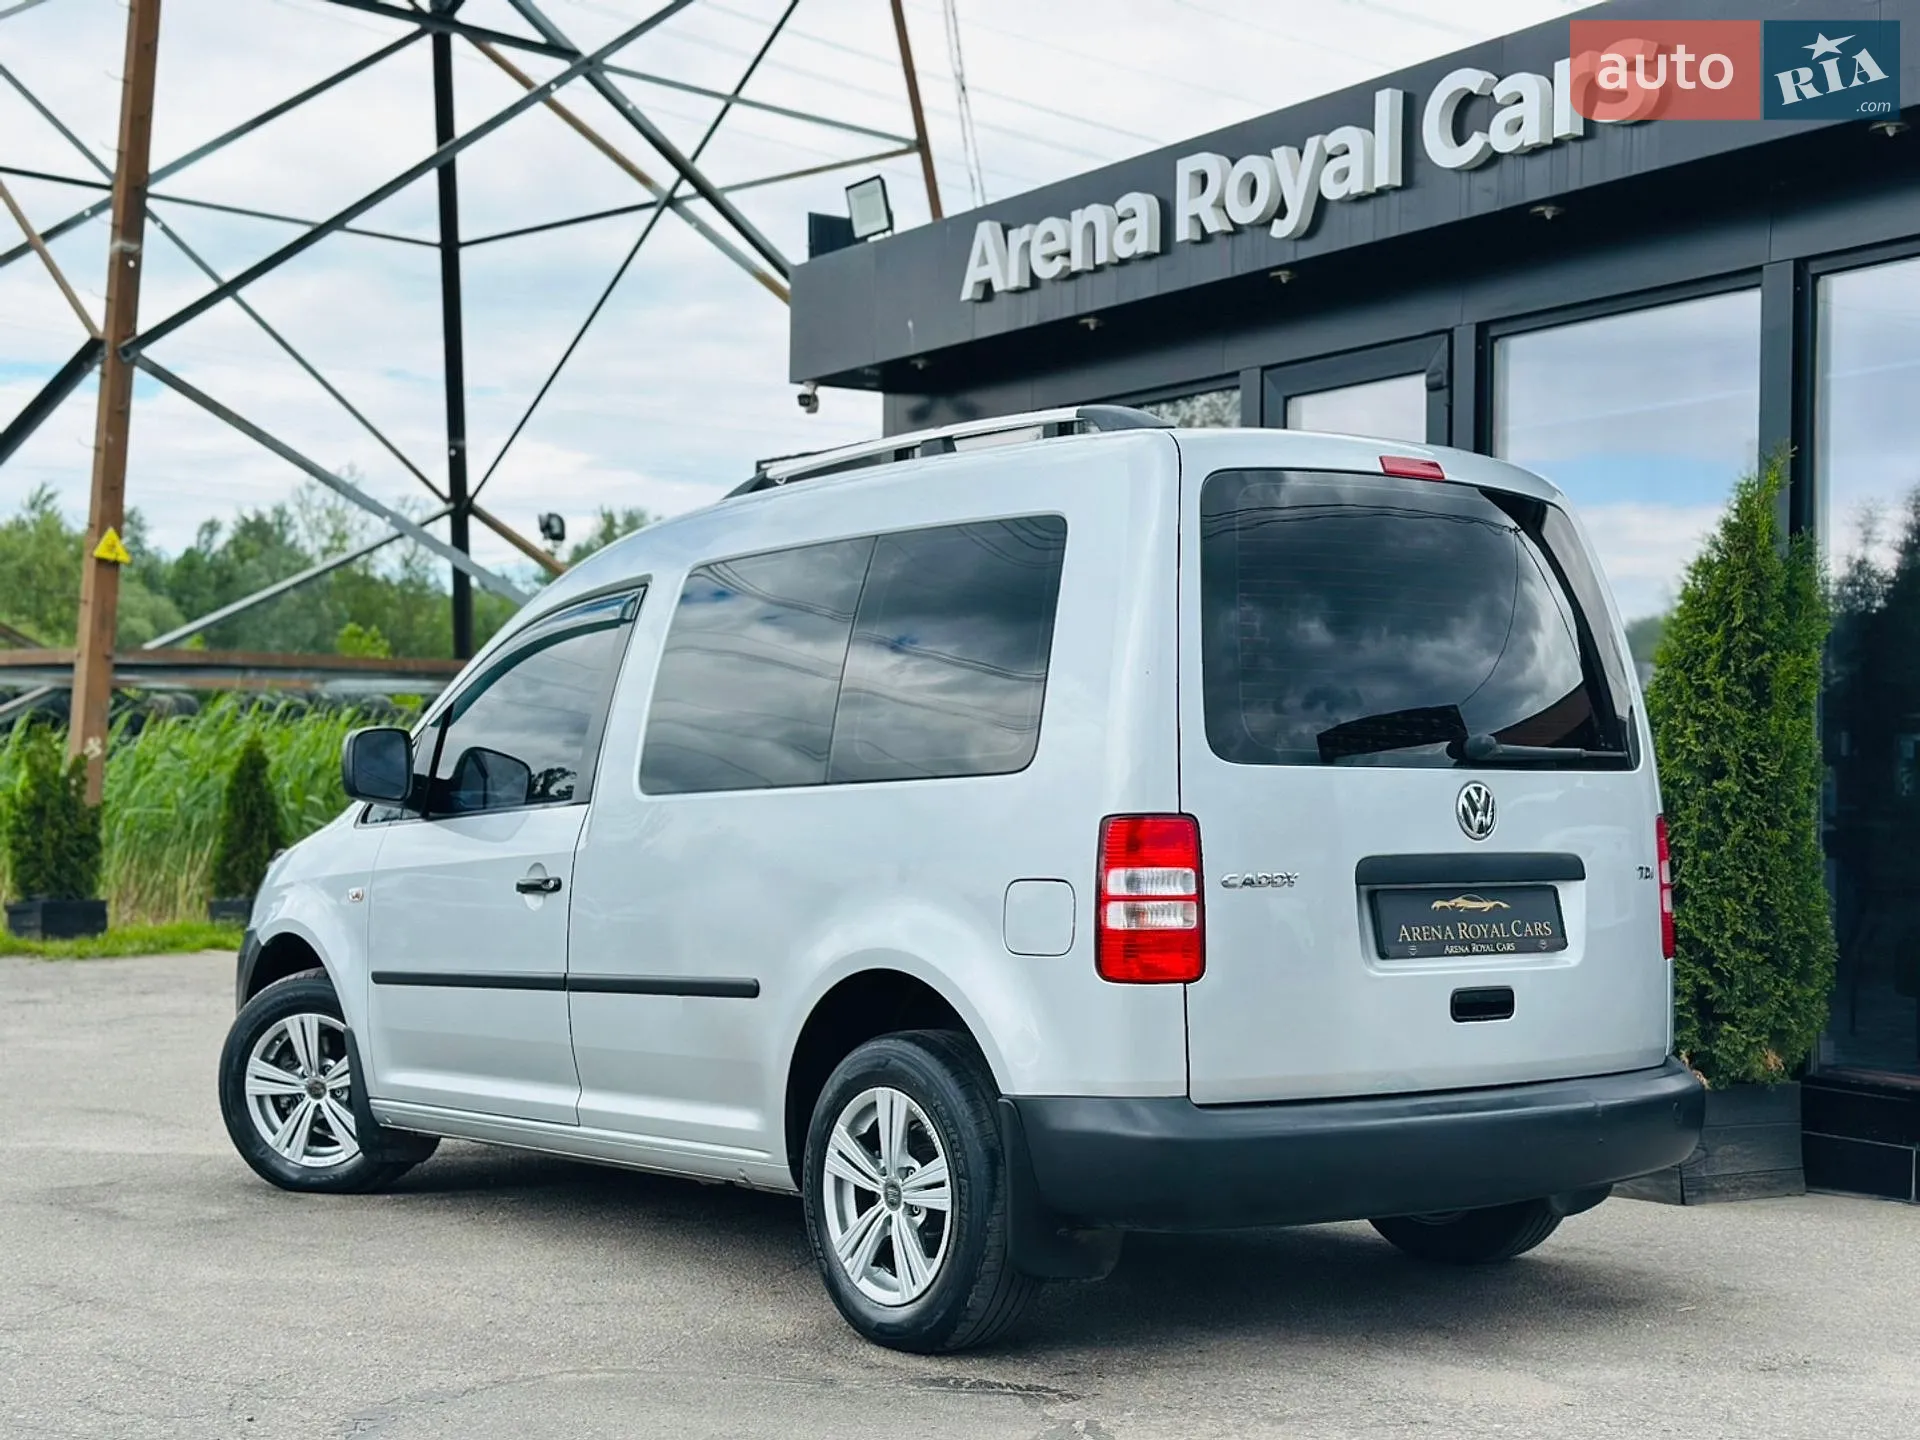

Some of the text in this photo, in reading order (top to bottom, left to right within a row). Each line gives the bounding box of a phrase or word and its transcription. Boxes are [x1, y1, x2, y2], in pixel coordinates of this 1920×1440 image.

[961, 38, 1660, 301] Arena Royal Cars
[1221, 872, 1299, 889] CADDY
[1398, 919, 1553, 942] ARENA ROYAL CARS
[1444, 942, 1516, 954] ARENA ROYAL CARS
